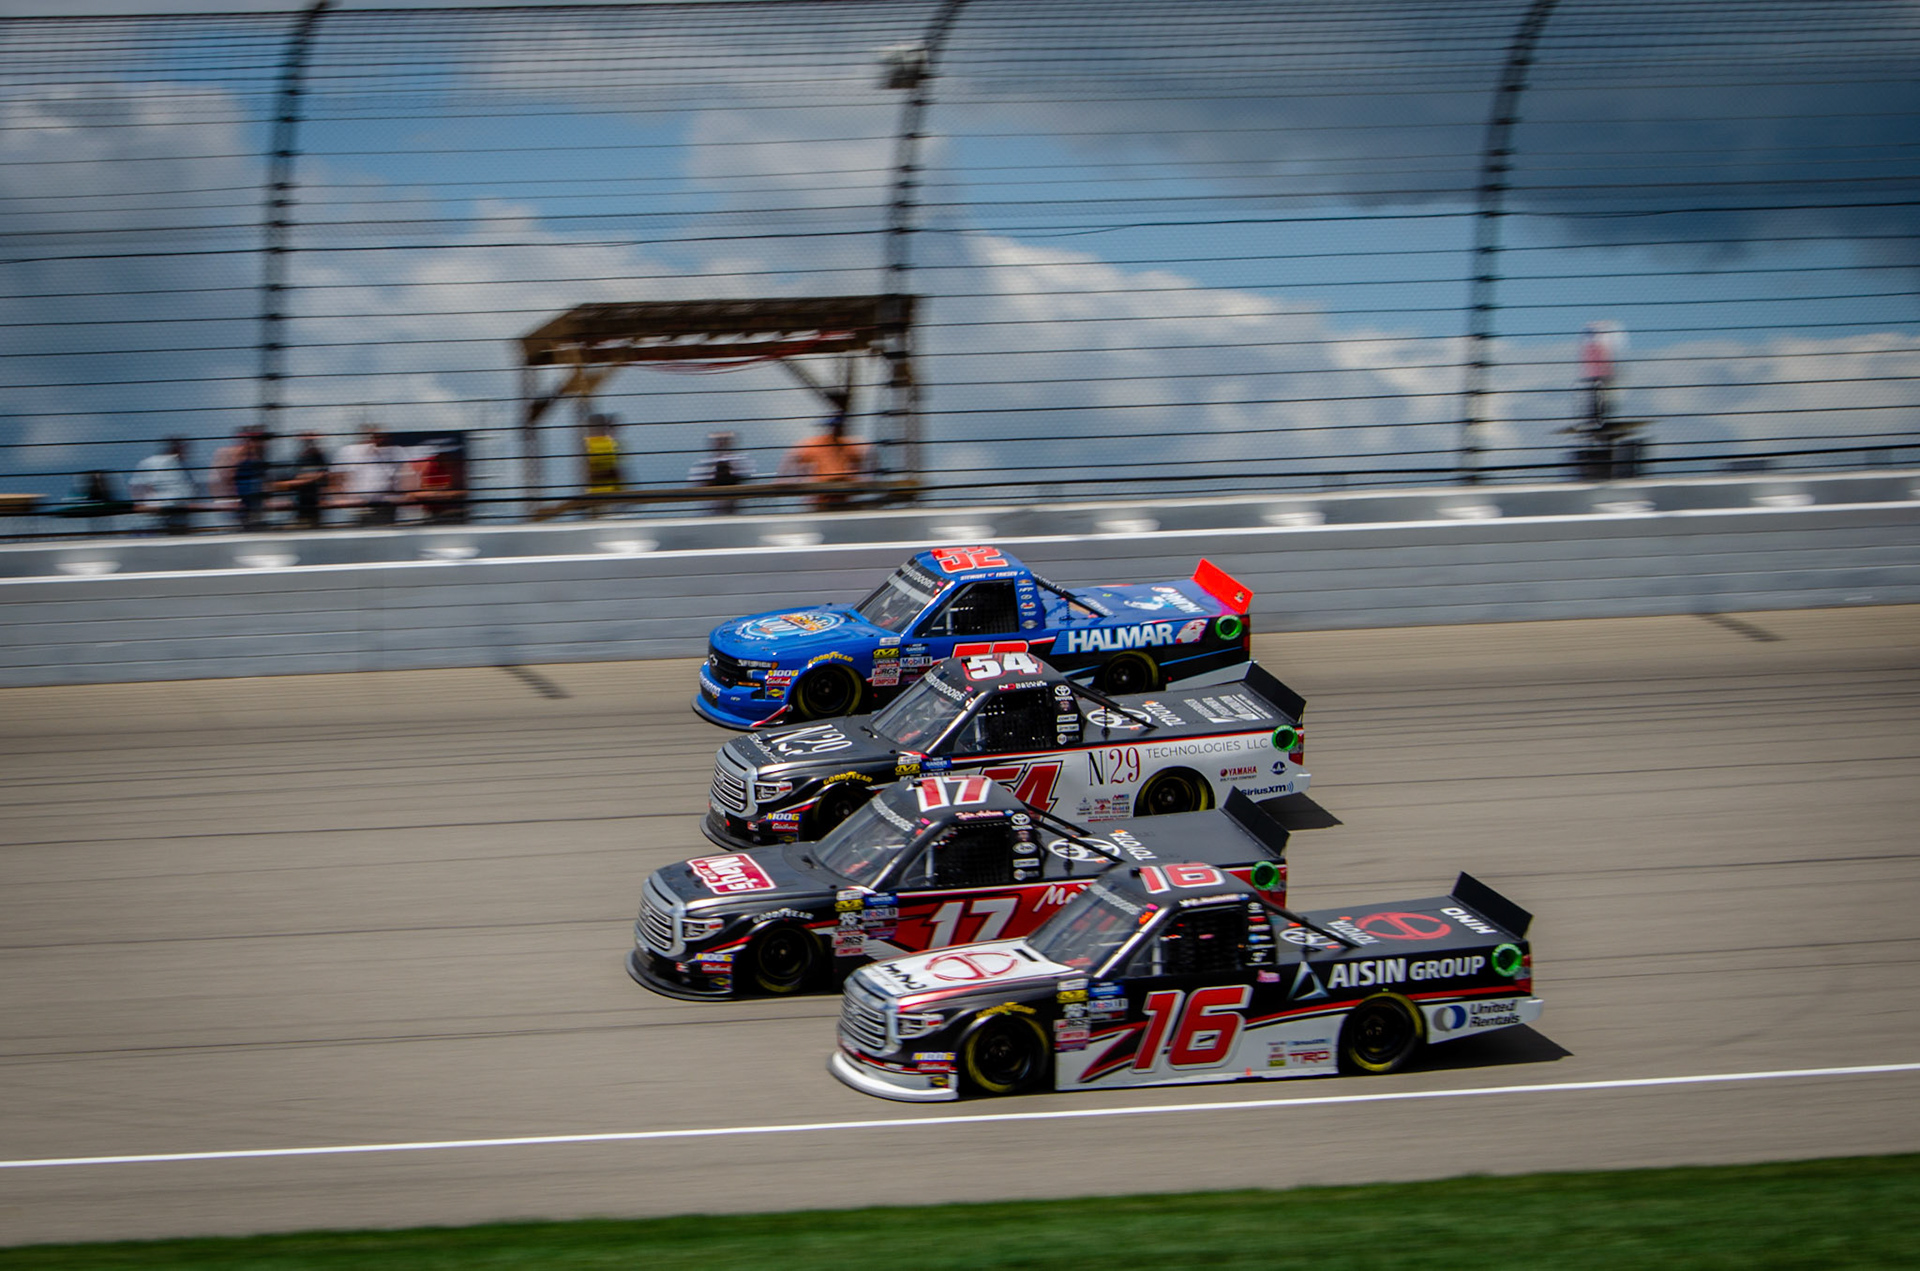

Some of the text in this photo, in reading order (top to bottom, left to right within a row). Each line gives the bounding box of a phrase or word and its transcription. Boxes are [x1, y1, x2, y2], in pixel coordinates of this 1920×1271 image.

[935, 547, 1008, 573] 52
[1068, 623, 1173, 652] HALMAR
[808, 651, 854, 668] GOODYEAR
[965, 652, 1040, 681] 54
[767, 669, 799, 677] MOOG
[1147, 738, 1268, 759] TECHNOLOGIES LLC
[823, 771, 873, 786] GOODYEAR
[1228, 766, 1257, 776] YAMAHA
[906, 776, 993, 813] 17
[766, 812, 800, 821] MOOG
[1139, 862, 1226, 895] 16
[928, 897, 1018, 951] 17
[1440, 907, 1498, 935] HINO
[1327, 955, 1486, 989] AISIN GROUP
[1469, 1000, 1516, 1014] United
[1469, 1013, 1521, 1027] Rentals
[1129, 984, 1254, 1074] 16
